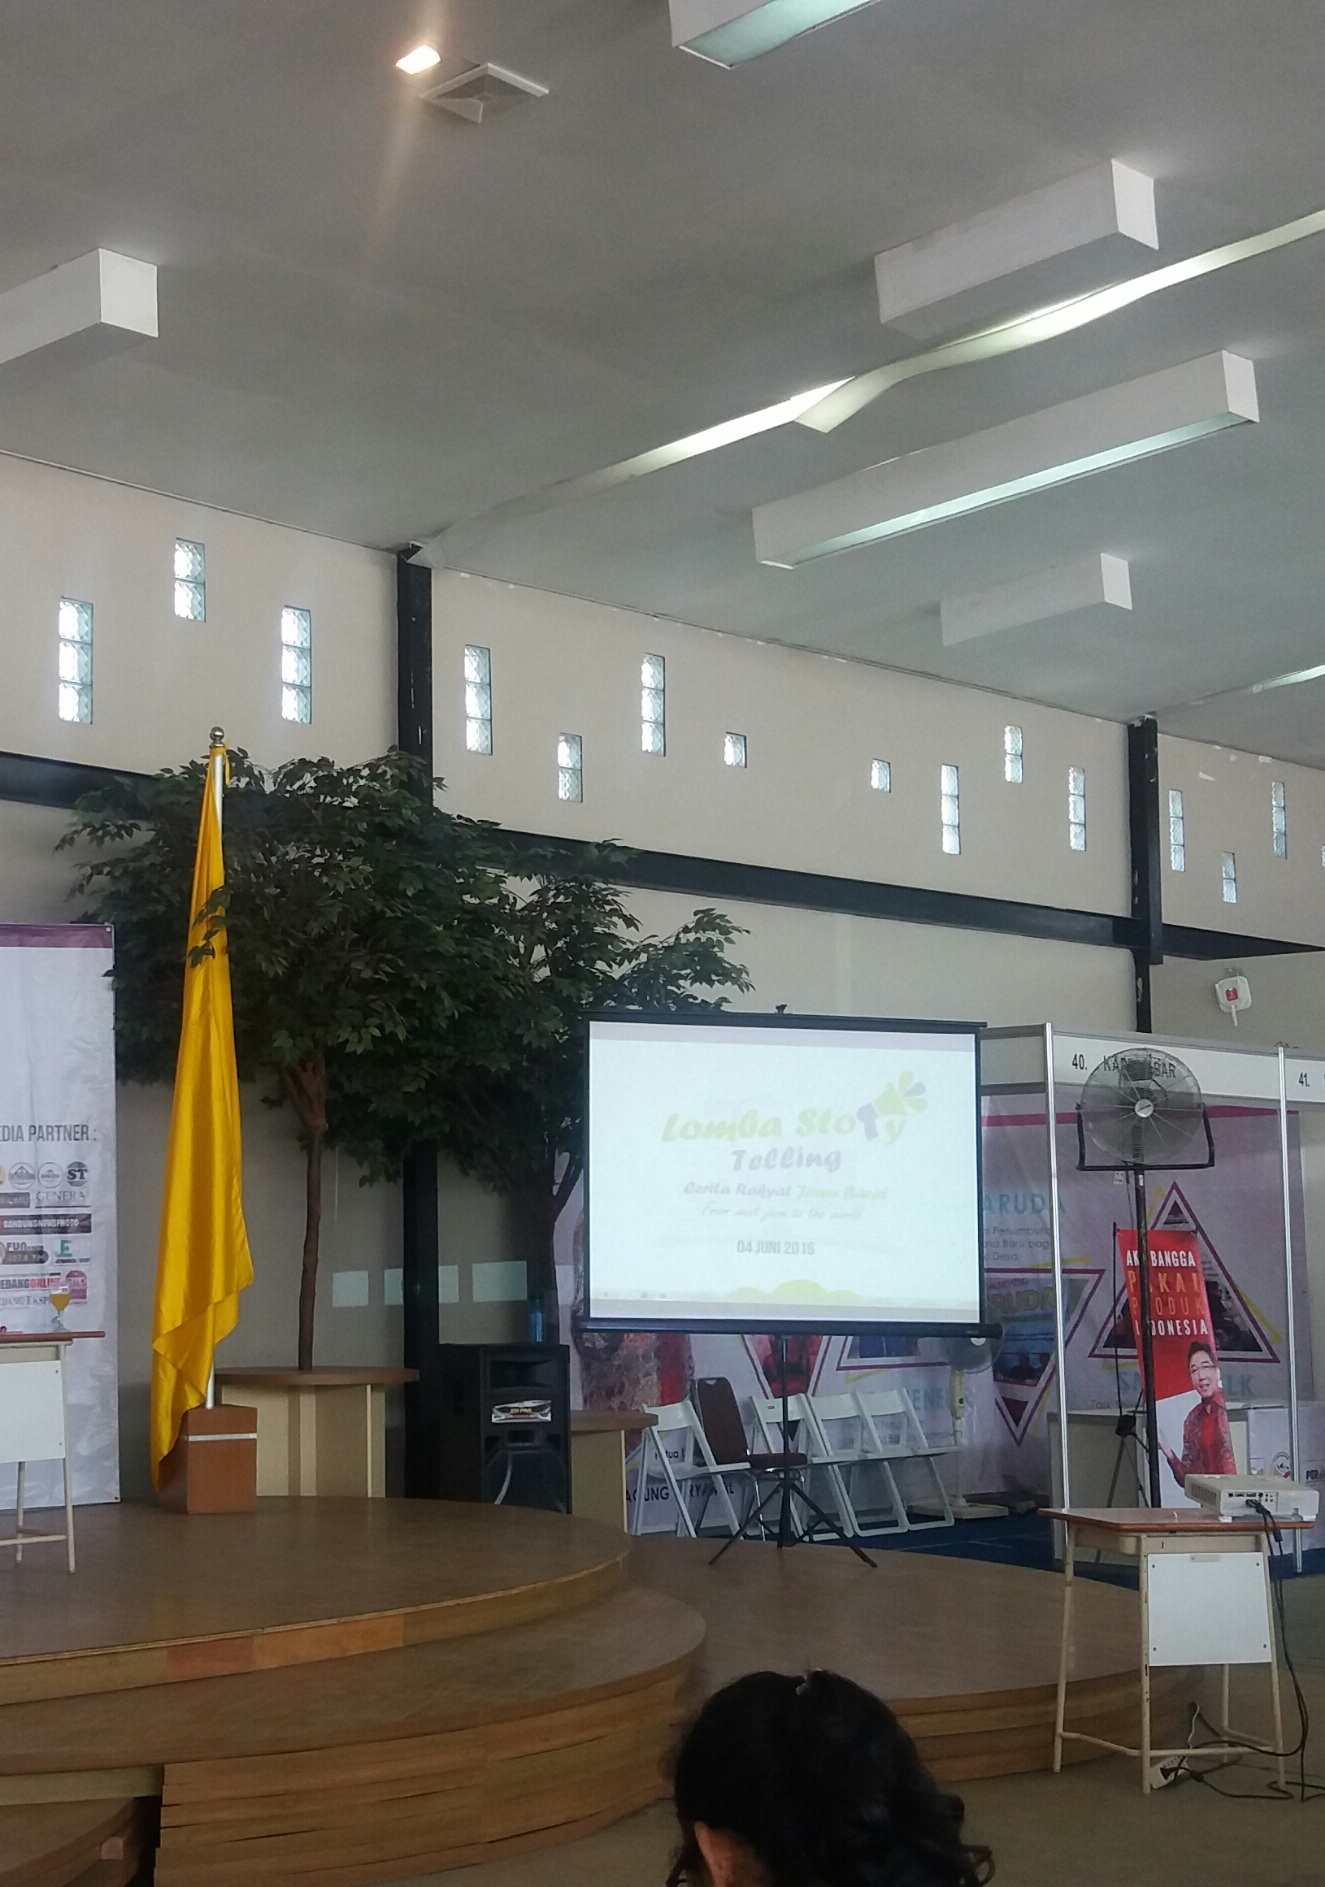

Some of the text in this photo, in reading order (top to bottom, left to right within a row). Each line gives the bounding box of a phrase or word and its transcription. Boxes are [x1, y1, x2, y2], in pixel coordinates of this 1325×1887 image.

[661, 1108, 783, 1142] Lomba
[731, 1146, 842, 1173] Telling
[683, 1181, 731, 1196] Cerita
[736, 1182, 791, 1198] Rakyat
[736, 1239, 816, 1256] 04 JUNI 2016
[1150, 1250, 1196, 1267] BANGGA
[1127, 1270, 1200, 1293] PKAI
[1131, 1297, 1205, 1316] PODUK
[1135, 1319, 1209, 1337] IDONESIA
